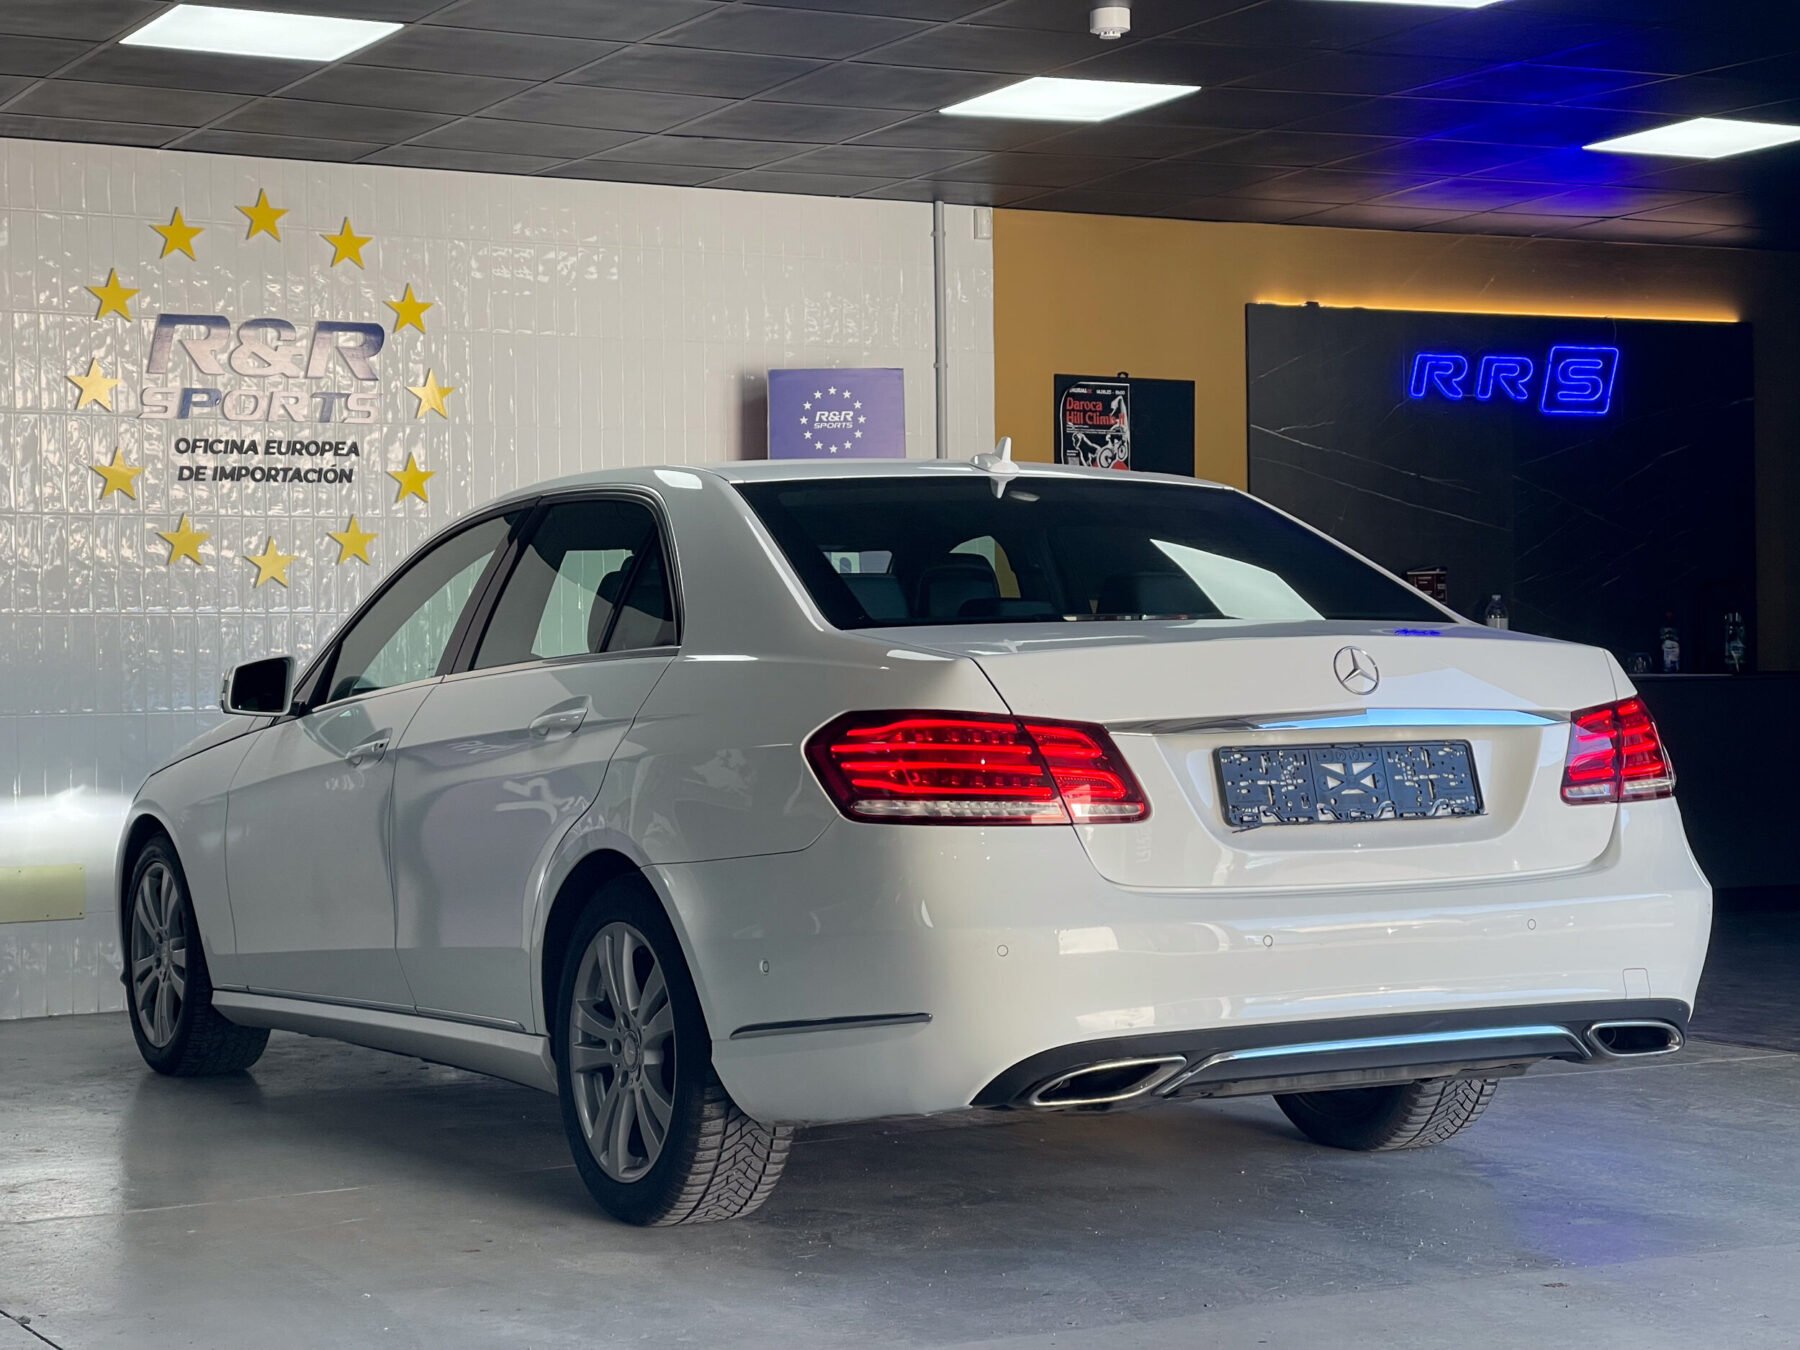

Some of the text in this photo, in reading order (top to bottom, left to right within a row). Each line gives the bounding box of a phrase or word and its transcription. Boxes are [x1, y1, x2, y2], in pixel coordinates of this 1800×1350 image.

[146, 314, 385, 380] R&R
[138, 387, 381, 423] SPORTS
[1066, 397, 1103, 410] Daroca
[815, 411, 854, 421] R&R
[1066, 411, 1083, 424] Hill
[174, 438, 361, 457] OFICINA EUROPEA
[177, 465, 354, 484] DE IMPORTACIÓN
